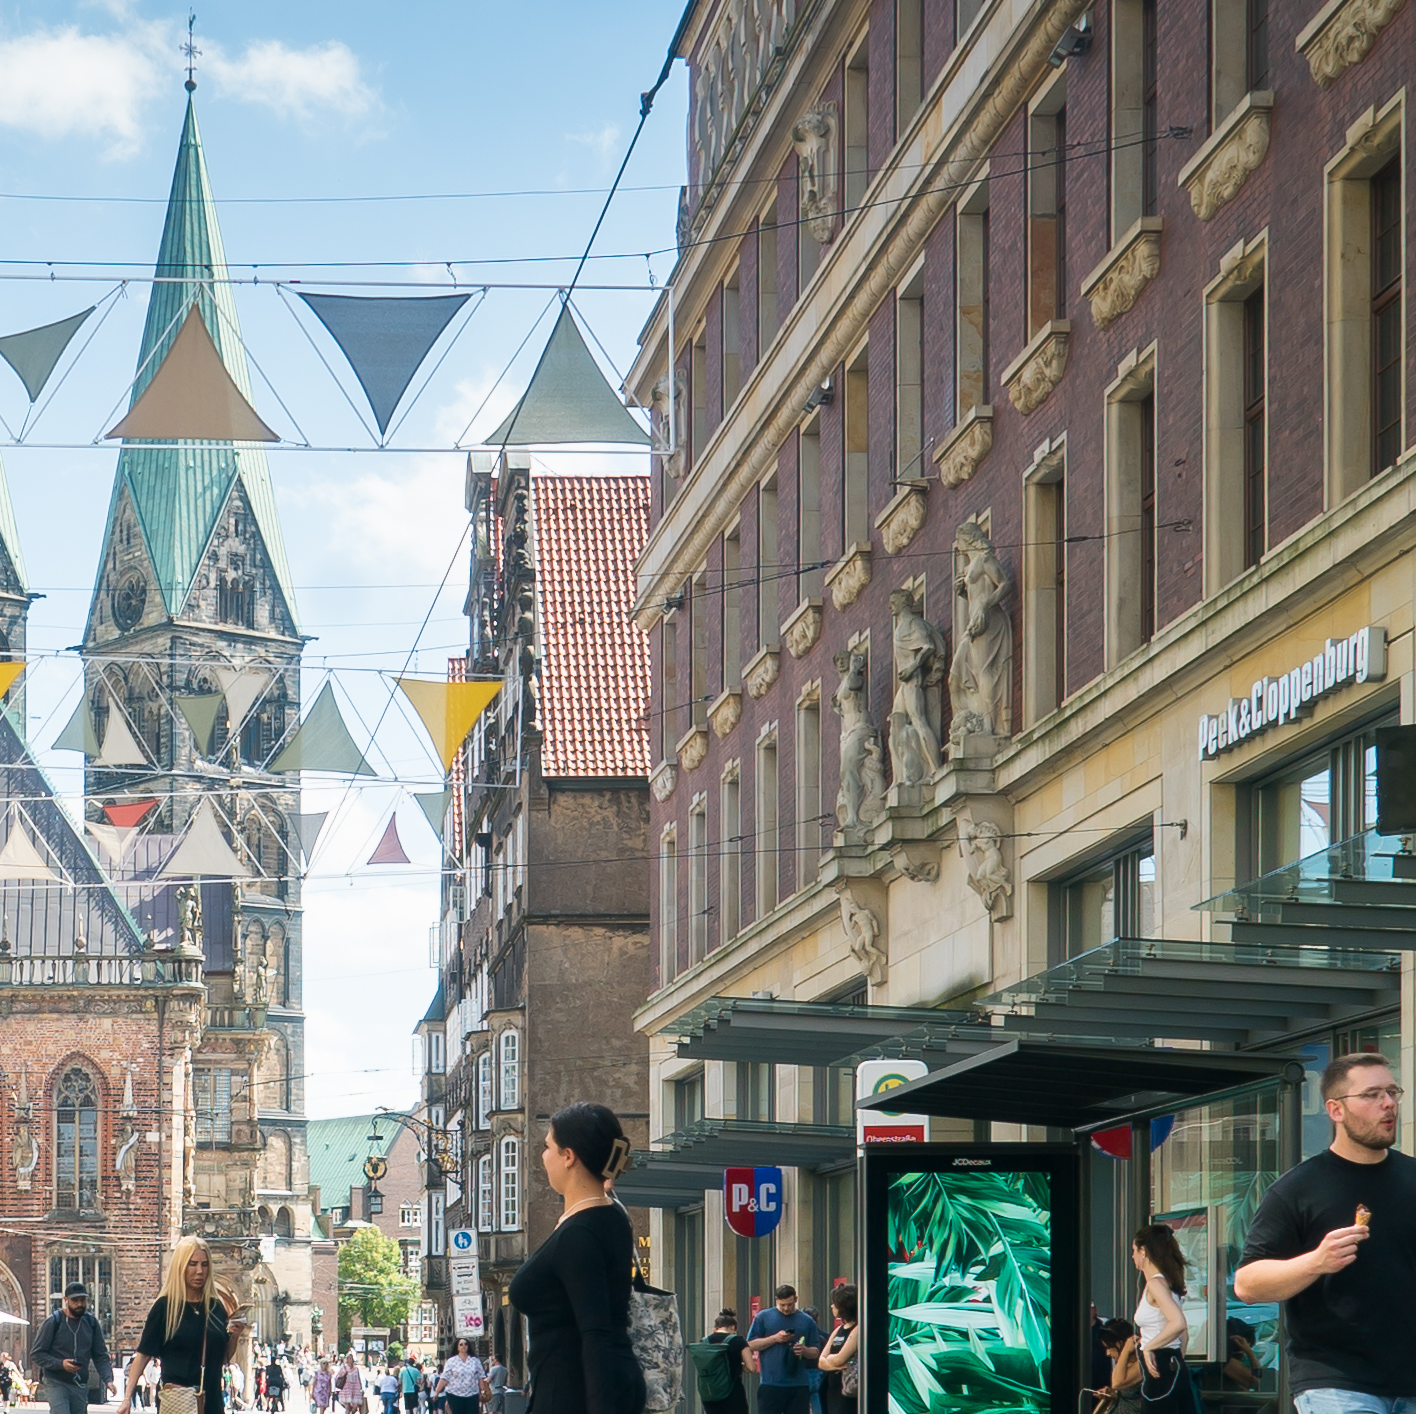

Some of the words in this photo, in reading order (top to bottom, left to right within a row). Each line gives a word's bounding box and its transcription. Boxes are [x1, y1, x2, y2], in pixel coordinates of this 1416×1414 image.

[1198, 626, 1371, 762] Peek&Cloppenburg
[952, 1158, 992, 1166] JCDecaux
[731, 1183, 777, 1213] P&C
